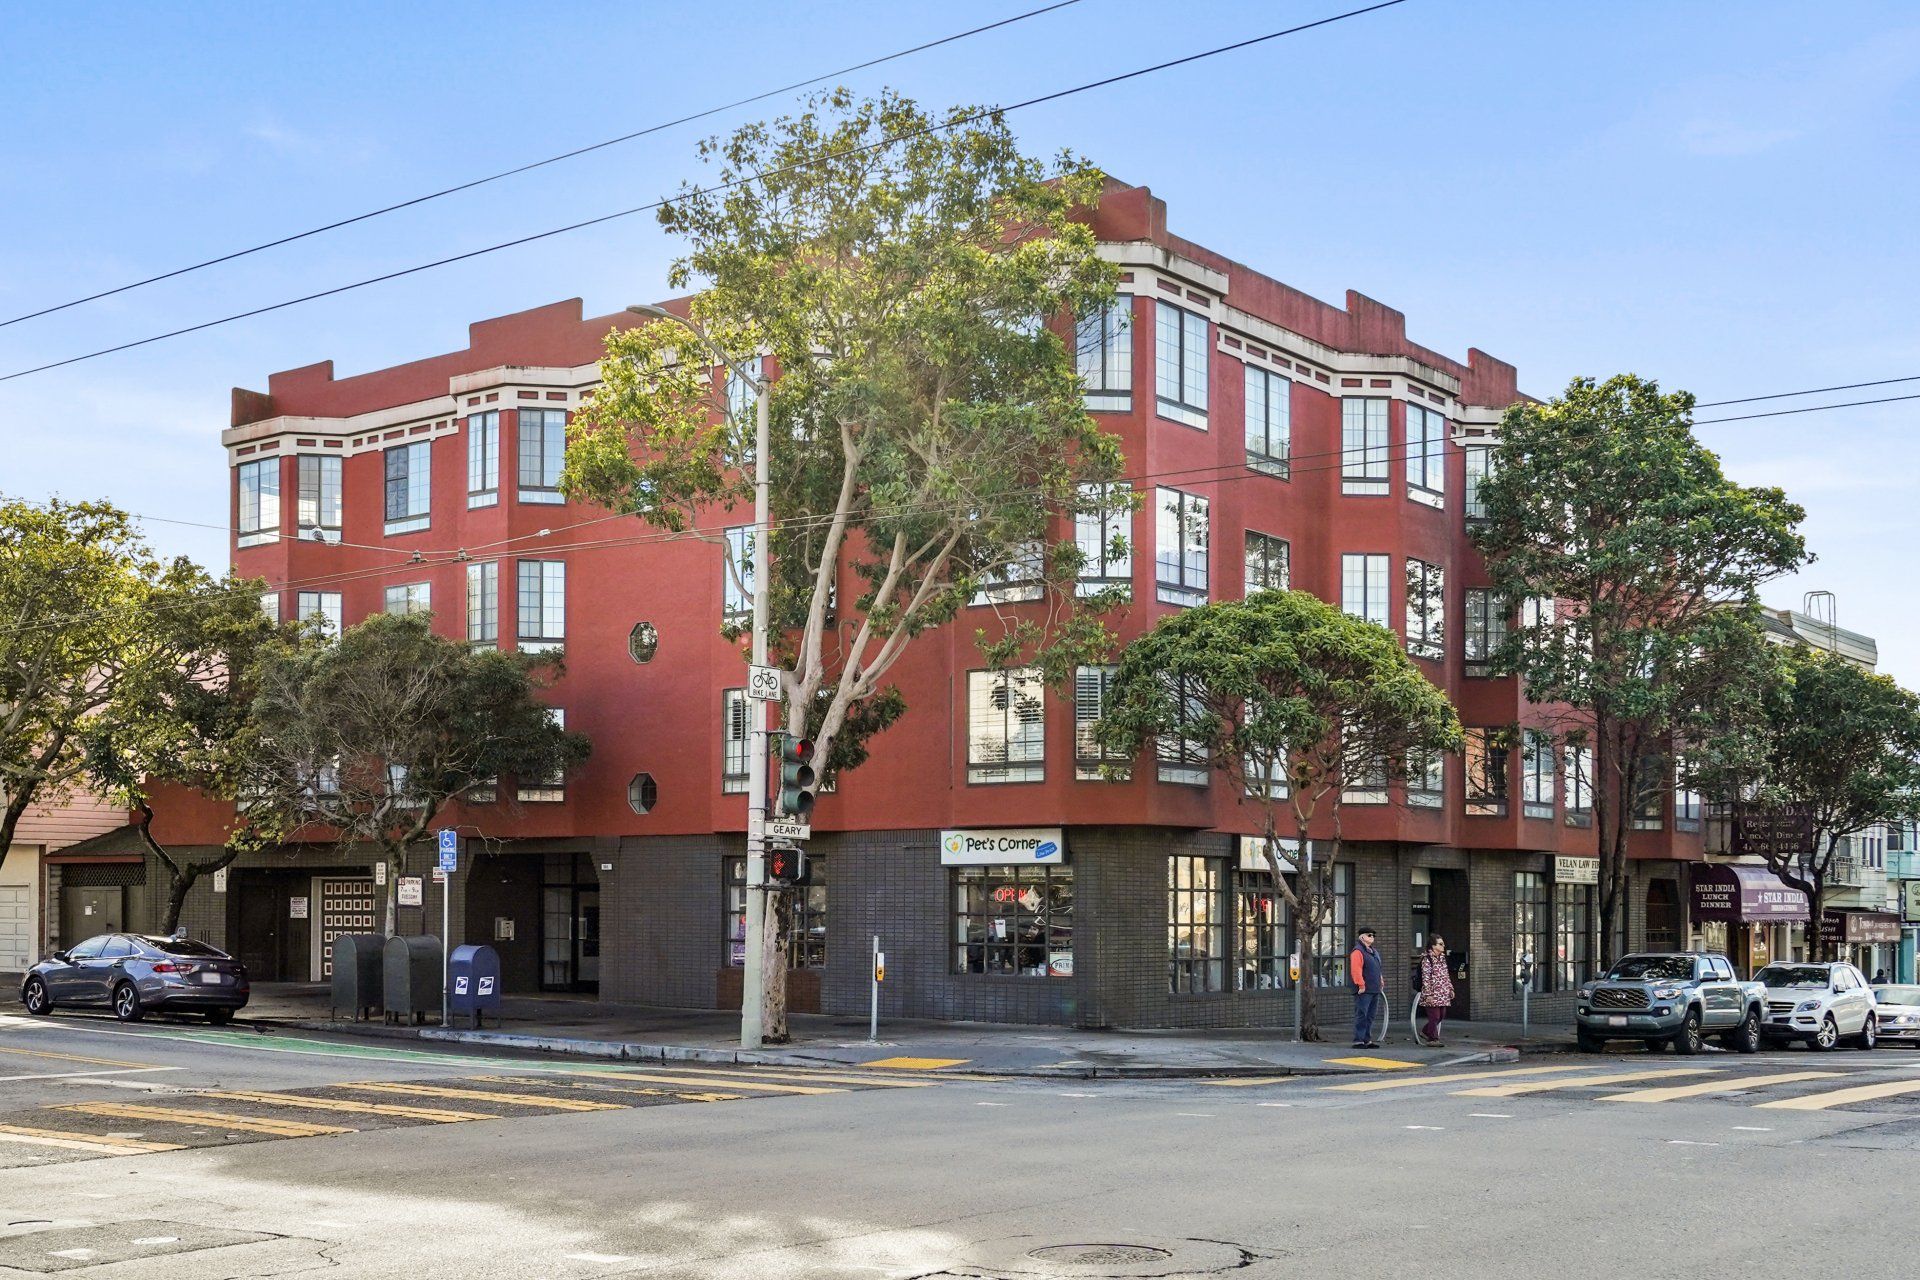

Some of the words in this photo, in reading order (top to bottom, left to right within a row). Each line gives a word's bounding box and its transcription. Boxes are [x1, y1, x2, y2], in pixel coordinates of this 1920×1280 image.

[753, 689, 764, 697] BIKE
[766, 690, 777, 699] LANE
[773, 825, 802, 835] GEARY
[966, 837, 995, 852] Pet's
[998, 837, 1042, 852] Corner
[1559, 859, 1577, 868] VELAN
[1578, 860, 1590, 868] LAW
[1591, 860, 1600, 869] FIR
[1695, 884, 1713, 892] STAR
[1715, 884, 1736, 892] INDIA
[1763, 892, 1782, 903] STAR
[1783, 892, 1804, 903] INDIA
